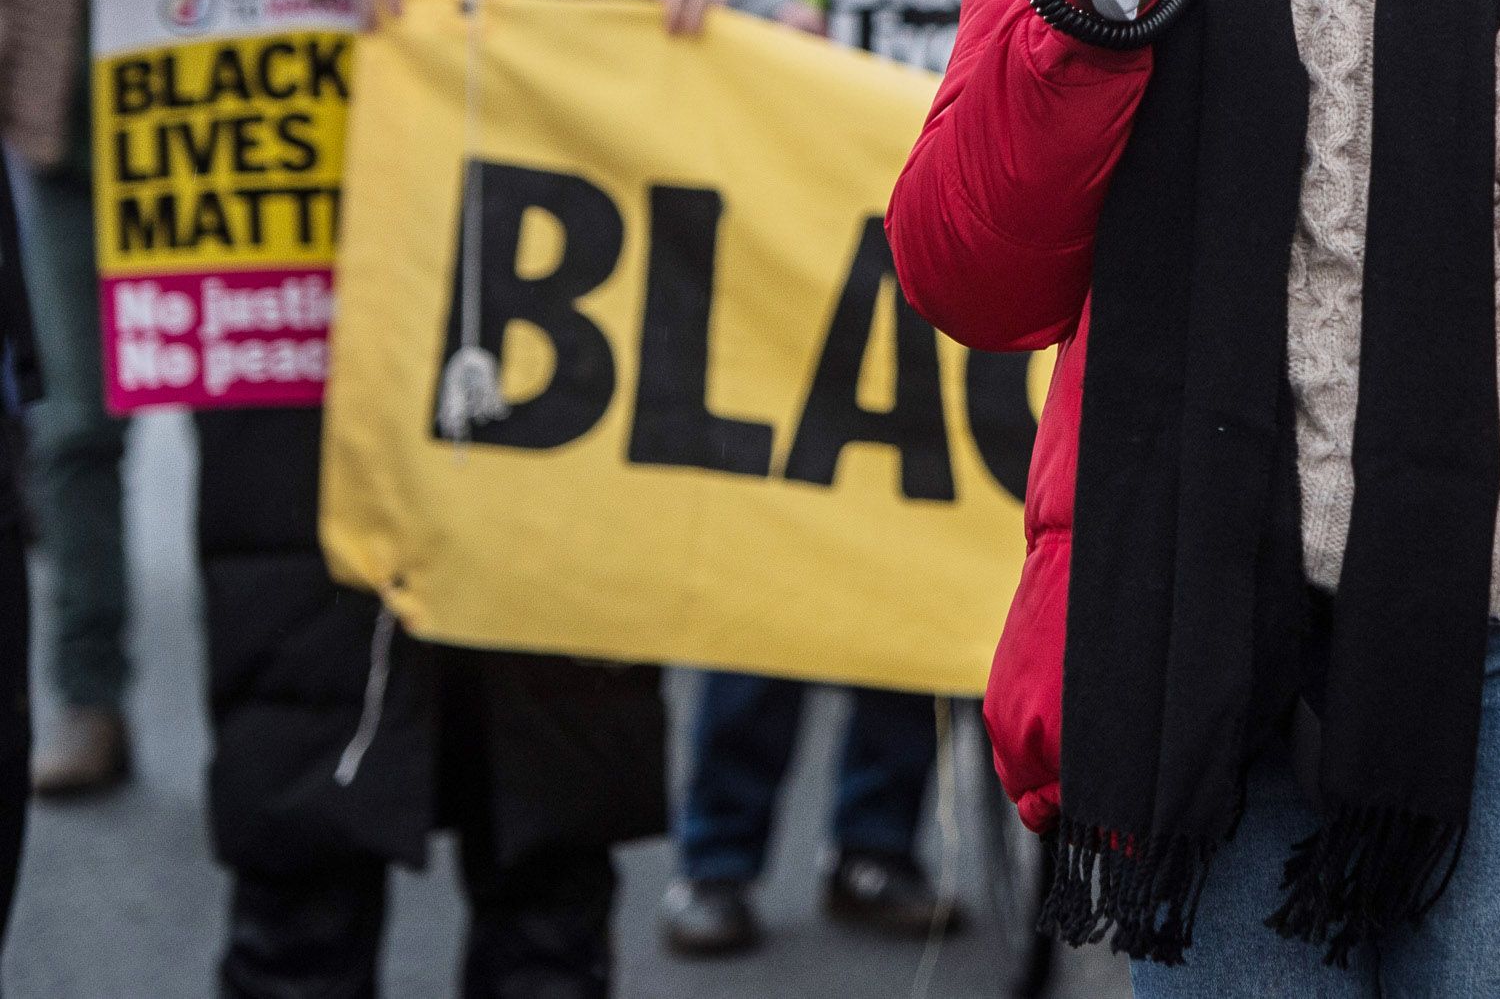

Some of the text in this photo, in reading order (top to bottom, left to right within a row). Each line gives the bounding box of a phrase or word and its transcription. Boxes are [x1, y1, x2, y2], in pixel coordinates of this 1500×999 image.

[112, 36, 351, 116] BLACK
[114, 114, 319, 184] LIVES
[113, 278, 199, 336] No
[114, 335, 200, 393] No
